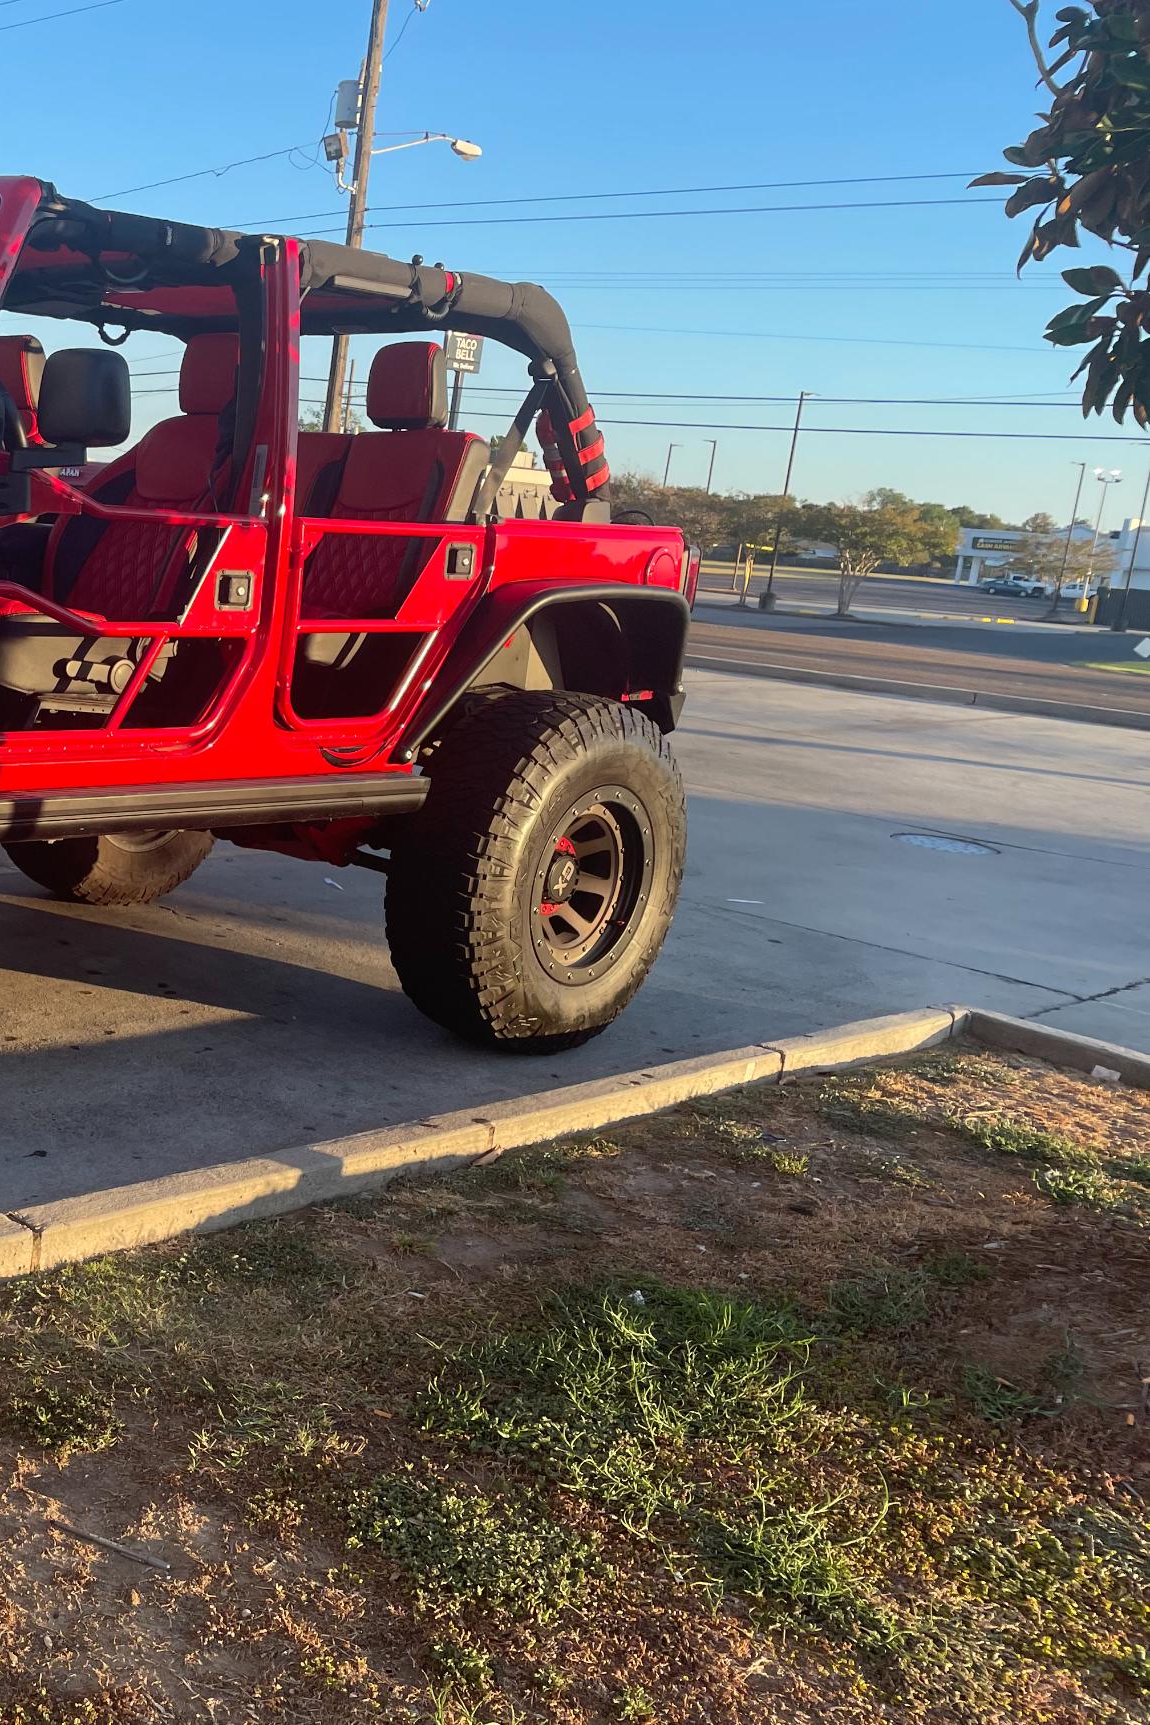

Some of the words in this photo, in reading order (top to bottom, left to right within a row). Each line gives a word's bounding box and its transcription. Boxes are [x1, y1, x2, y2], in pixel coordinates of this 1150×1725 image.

[456, 337, 478, 350] TACO
[455, 348, 475, 362] BELL
[60, 466, 80, 477] APAN
